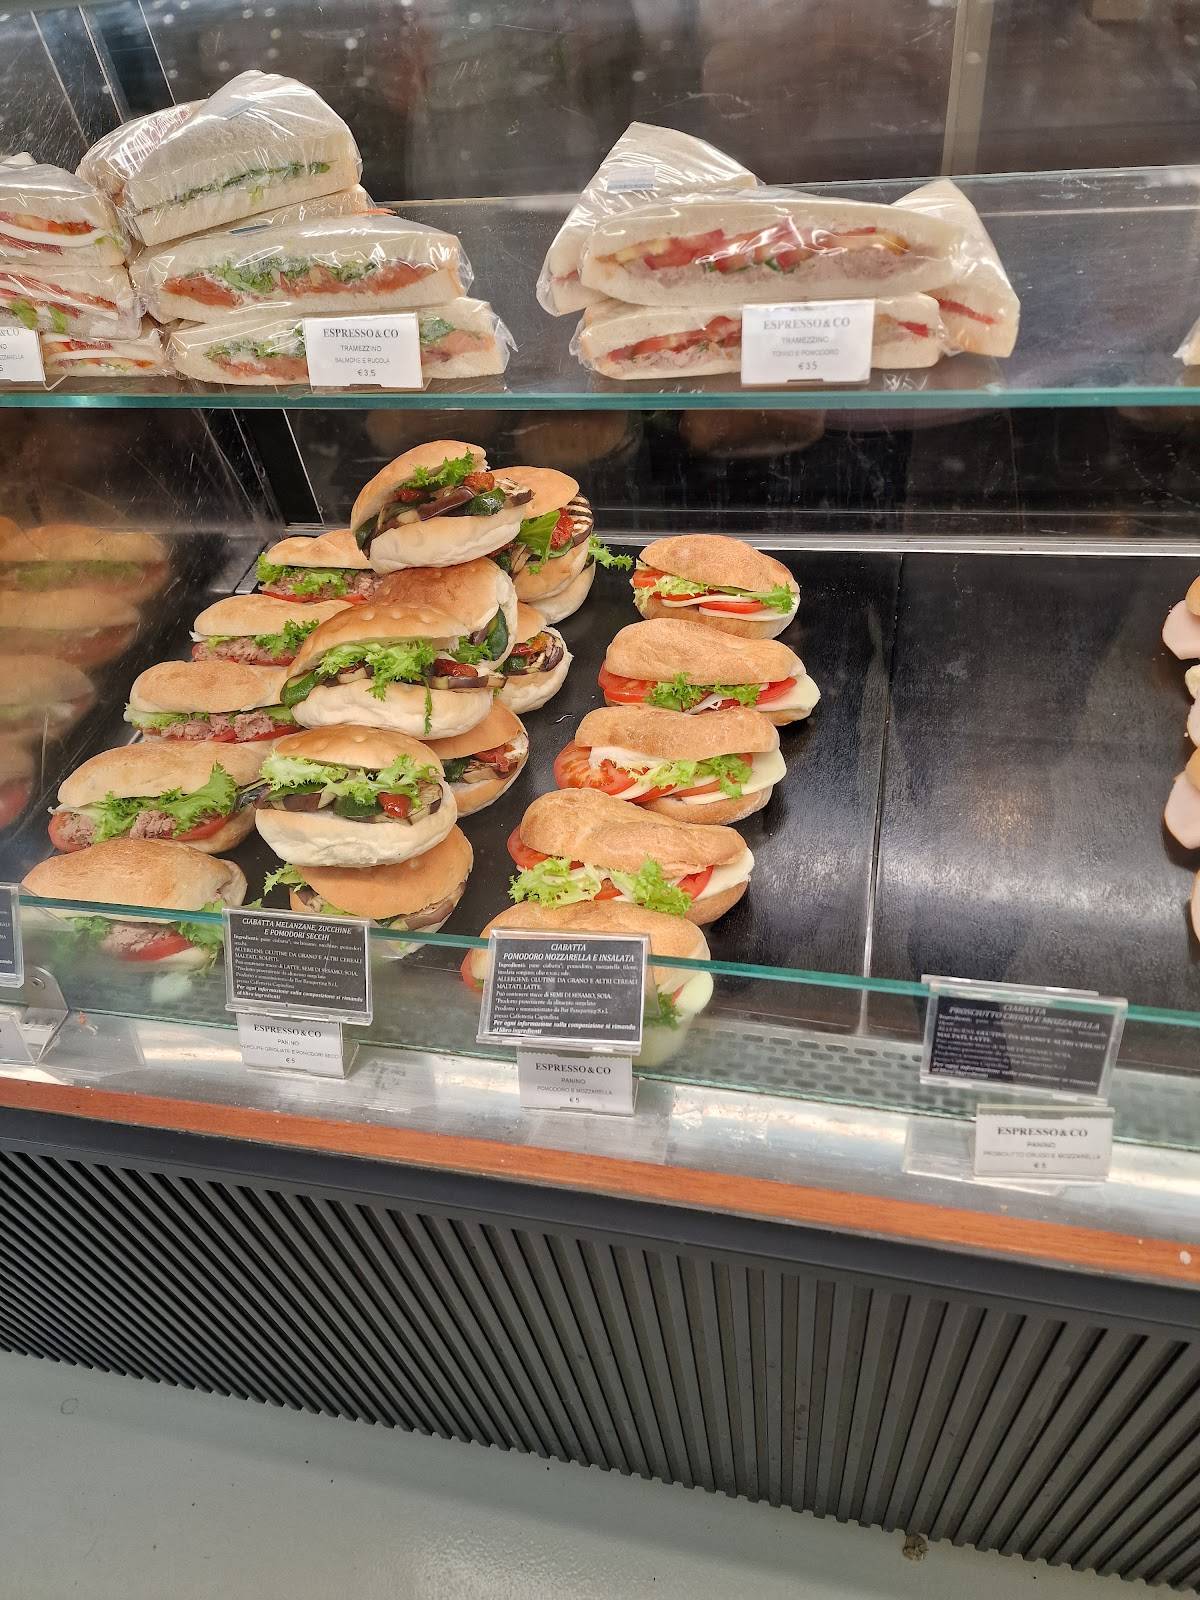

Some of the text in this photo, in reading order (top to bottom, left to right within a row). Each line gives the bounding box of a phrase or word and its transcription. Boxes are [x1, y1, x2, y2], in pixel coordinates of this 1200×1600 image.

[781, 336, 830, 345] TRAMEZZINO
[801, 348, 840, 357] POMODORO
[242, 917, 352, 935] CIABATTA MELANZANE, ZUCCHINE
[264, 928, 330, 941] E POMODORI SECCHI
[550, 943, 586, 952] CIABATTA
[340, 956, 362, 964] CEREALI
[503, 952, 634, 963] POMODORO MOZZARELLA E INSALATA
[530, 976, 556, 984] GLUTINE
[567, 977, 589, 985] GRANO
[589, 977, 595, 985] E
[613, 978, 638, 986] CEREALI
[564, 991, 571, 999] DI
[1003, 1004, 1047, 1016] CIABATTA
[949, 1006, 1002, 1018] PROSCIUTTO
[1003, 1012, 1034, 1023] CRUDO
[1042, 1017, 1100, 1031] MOZZARELLA
[517, 1020, 553, 1028] informazione
[568, 1022, 605, 1030] composizione
[605, 1022, 611, 1030] si
[513, 1027, 542, 1035] ingredienti
[277, 1038, 300, 1047] PANINO
[561, 1077, 586, 1085] PANINO
[537, 1085, 569, 1093] POMODORO
